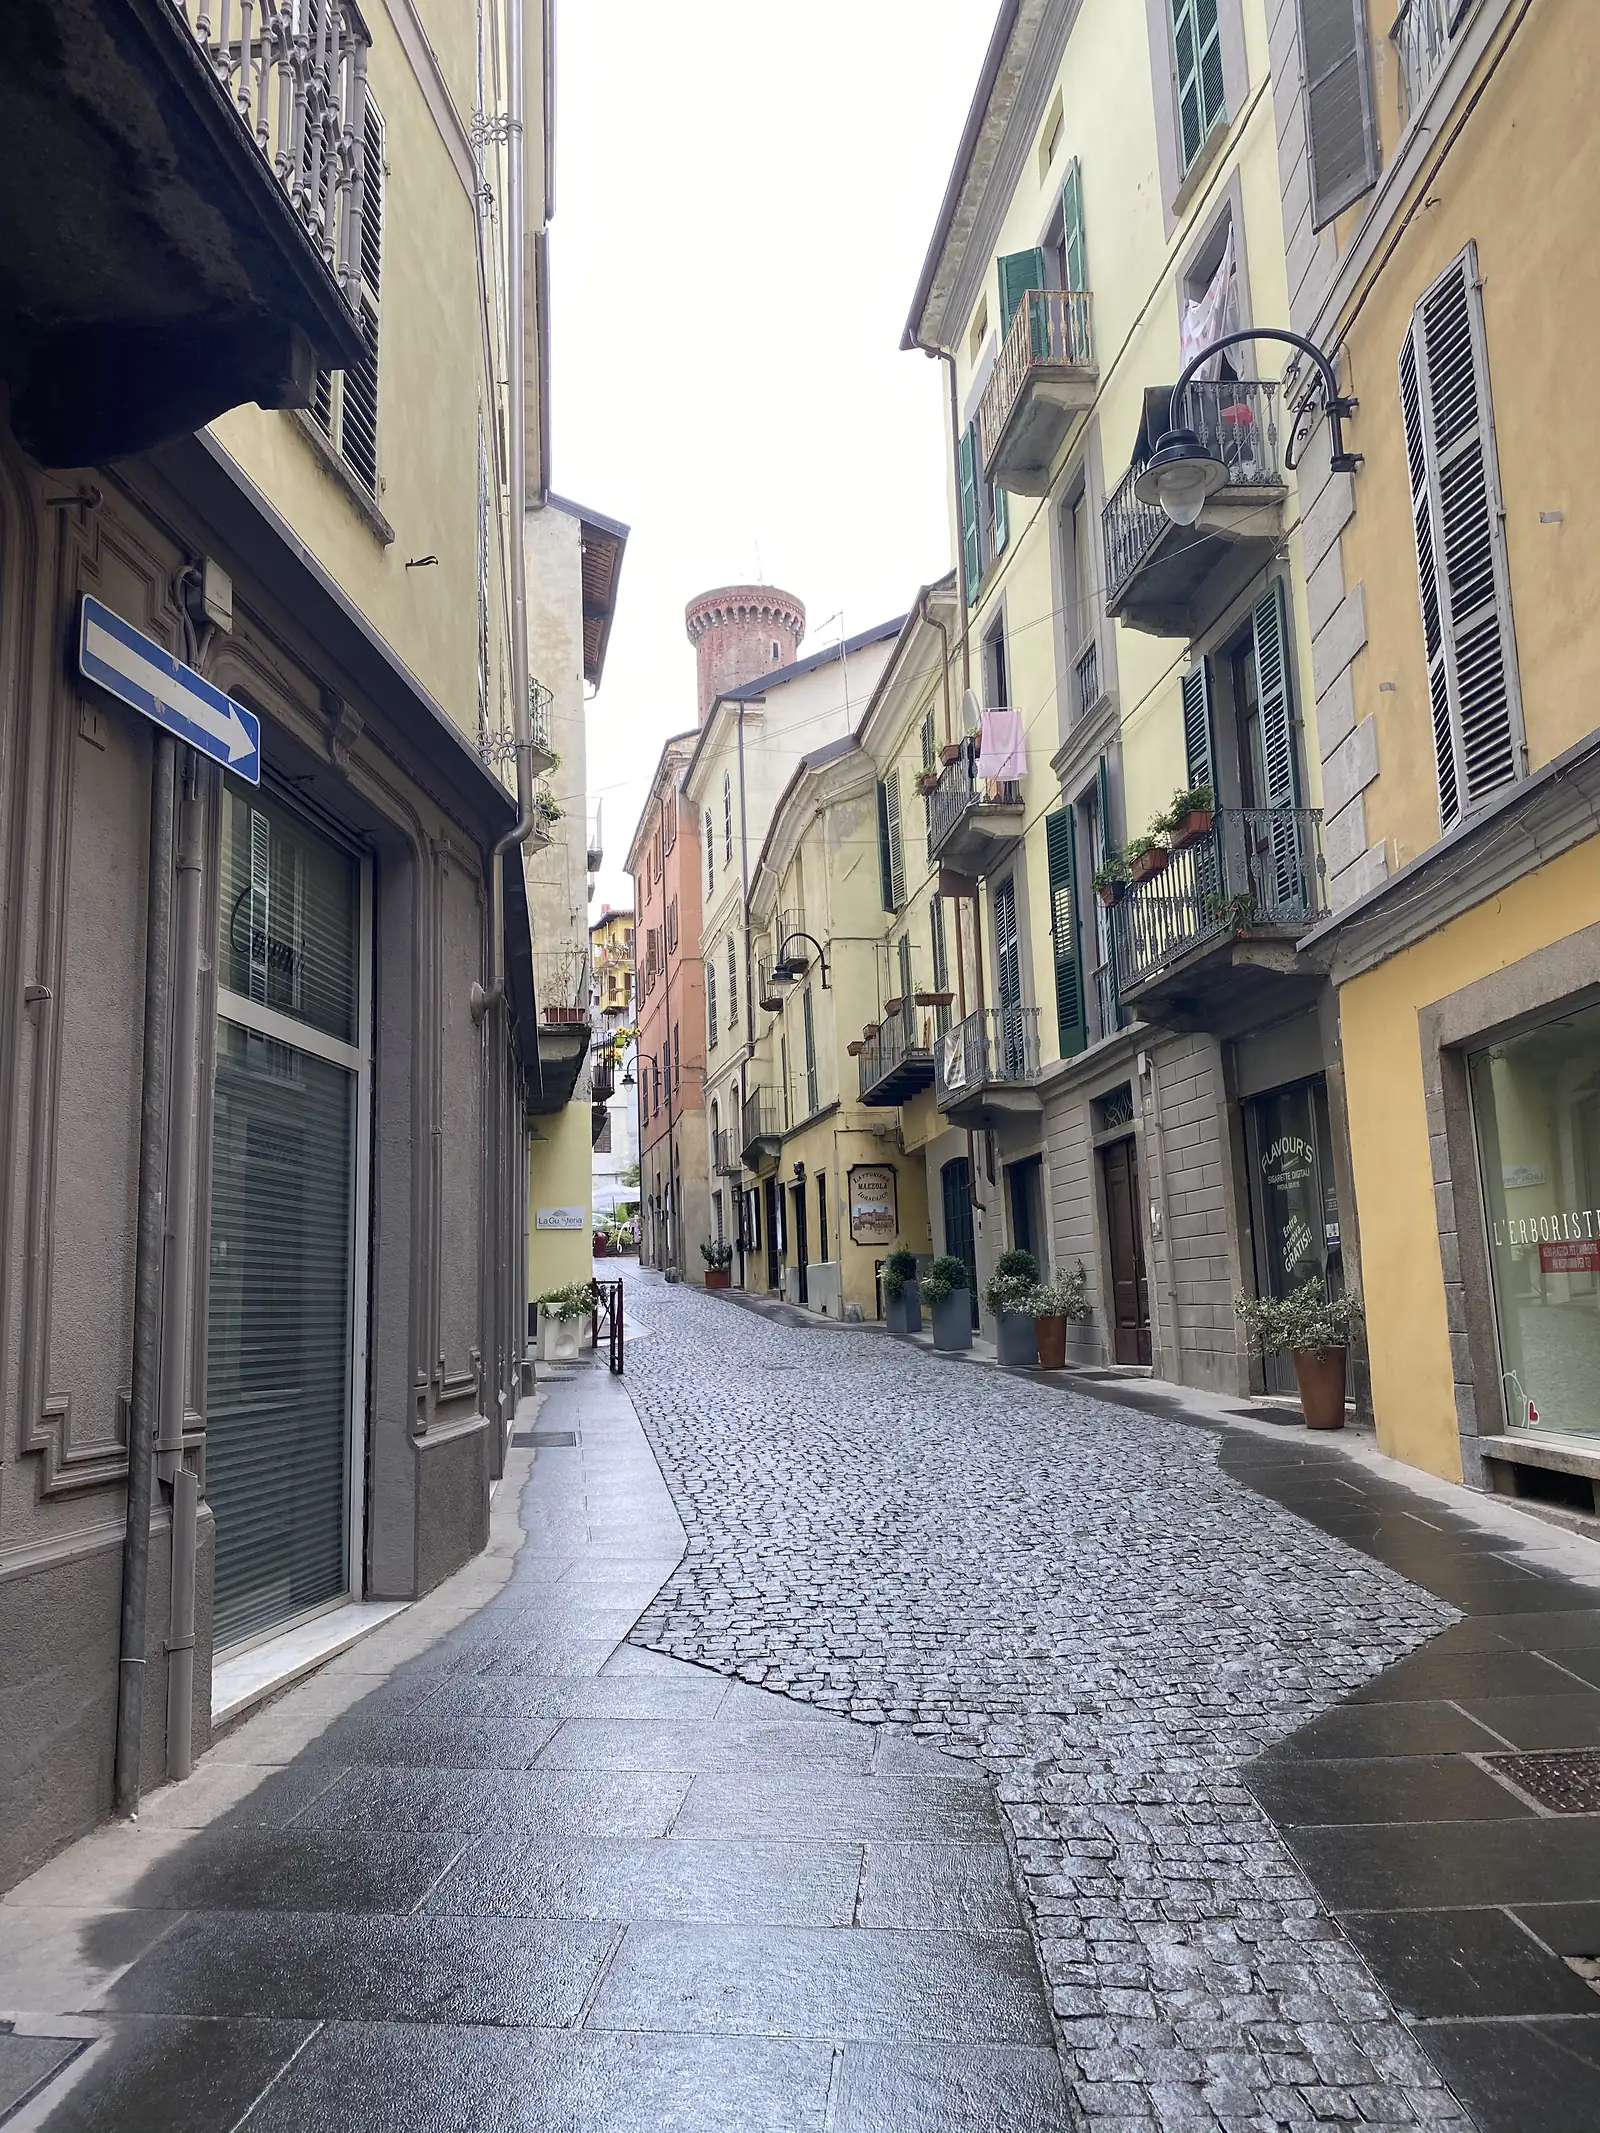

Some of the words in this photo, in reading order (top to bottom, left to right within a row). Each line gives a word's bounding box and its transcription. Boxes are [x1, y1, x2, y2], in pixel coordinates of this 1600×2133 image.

[1261, 1136, 1313, 1174] FLAVOUR'S
[1267, 1171, 1291, 1184] SIGARETTE
[1291, 1167, 1310, 1180] DIGITALI
[857, 1191, 888, 1201] IDRAULICO
[1282, 1214, 1298, 1238] Entra
[1282, 1246, 1287, 1255] e
[1284, 1226, 1313, 1273] GRATIS!!
